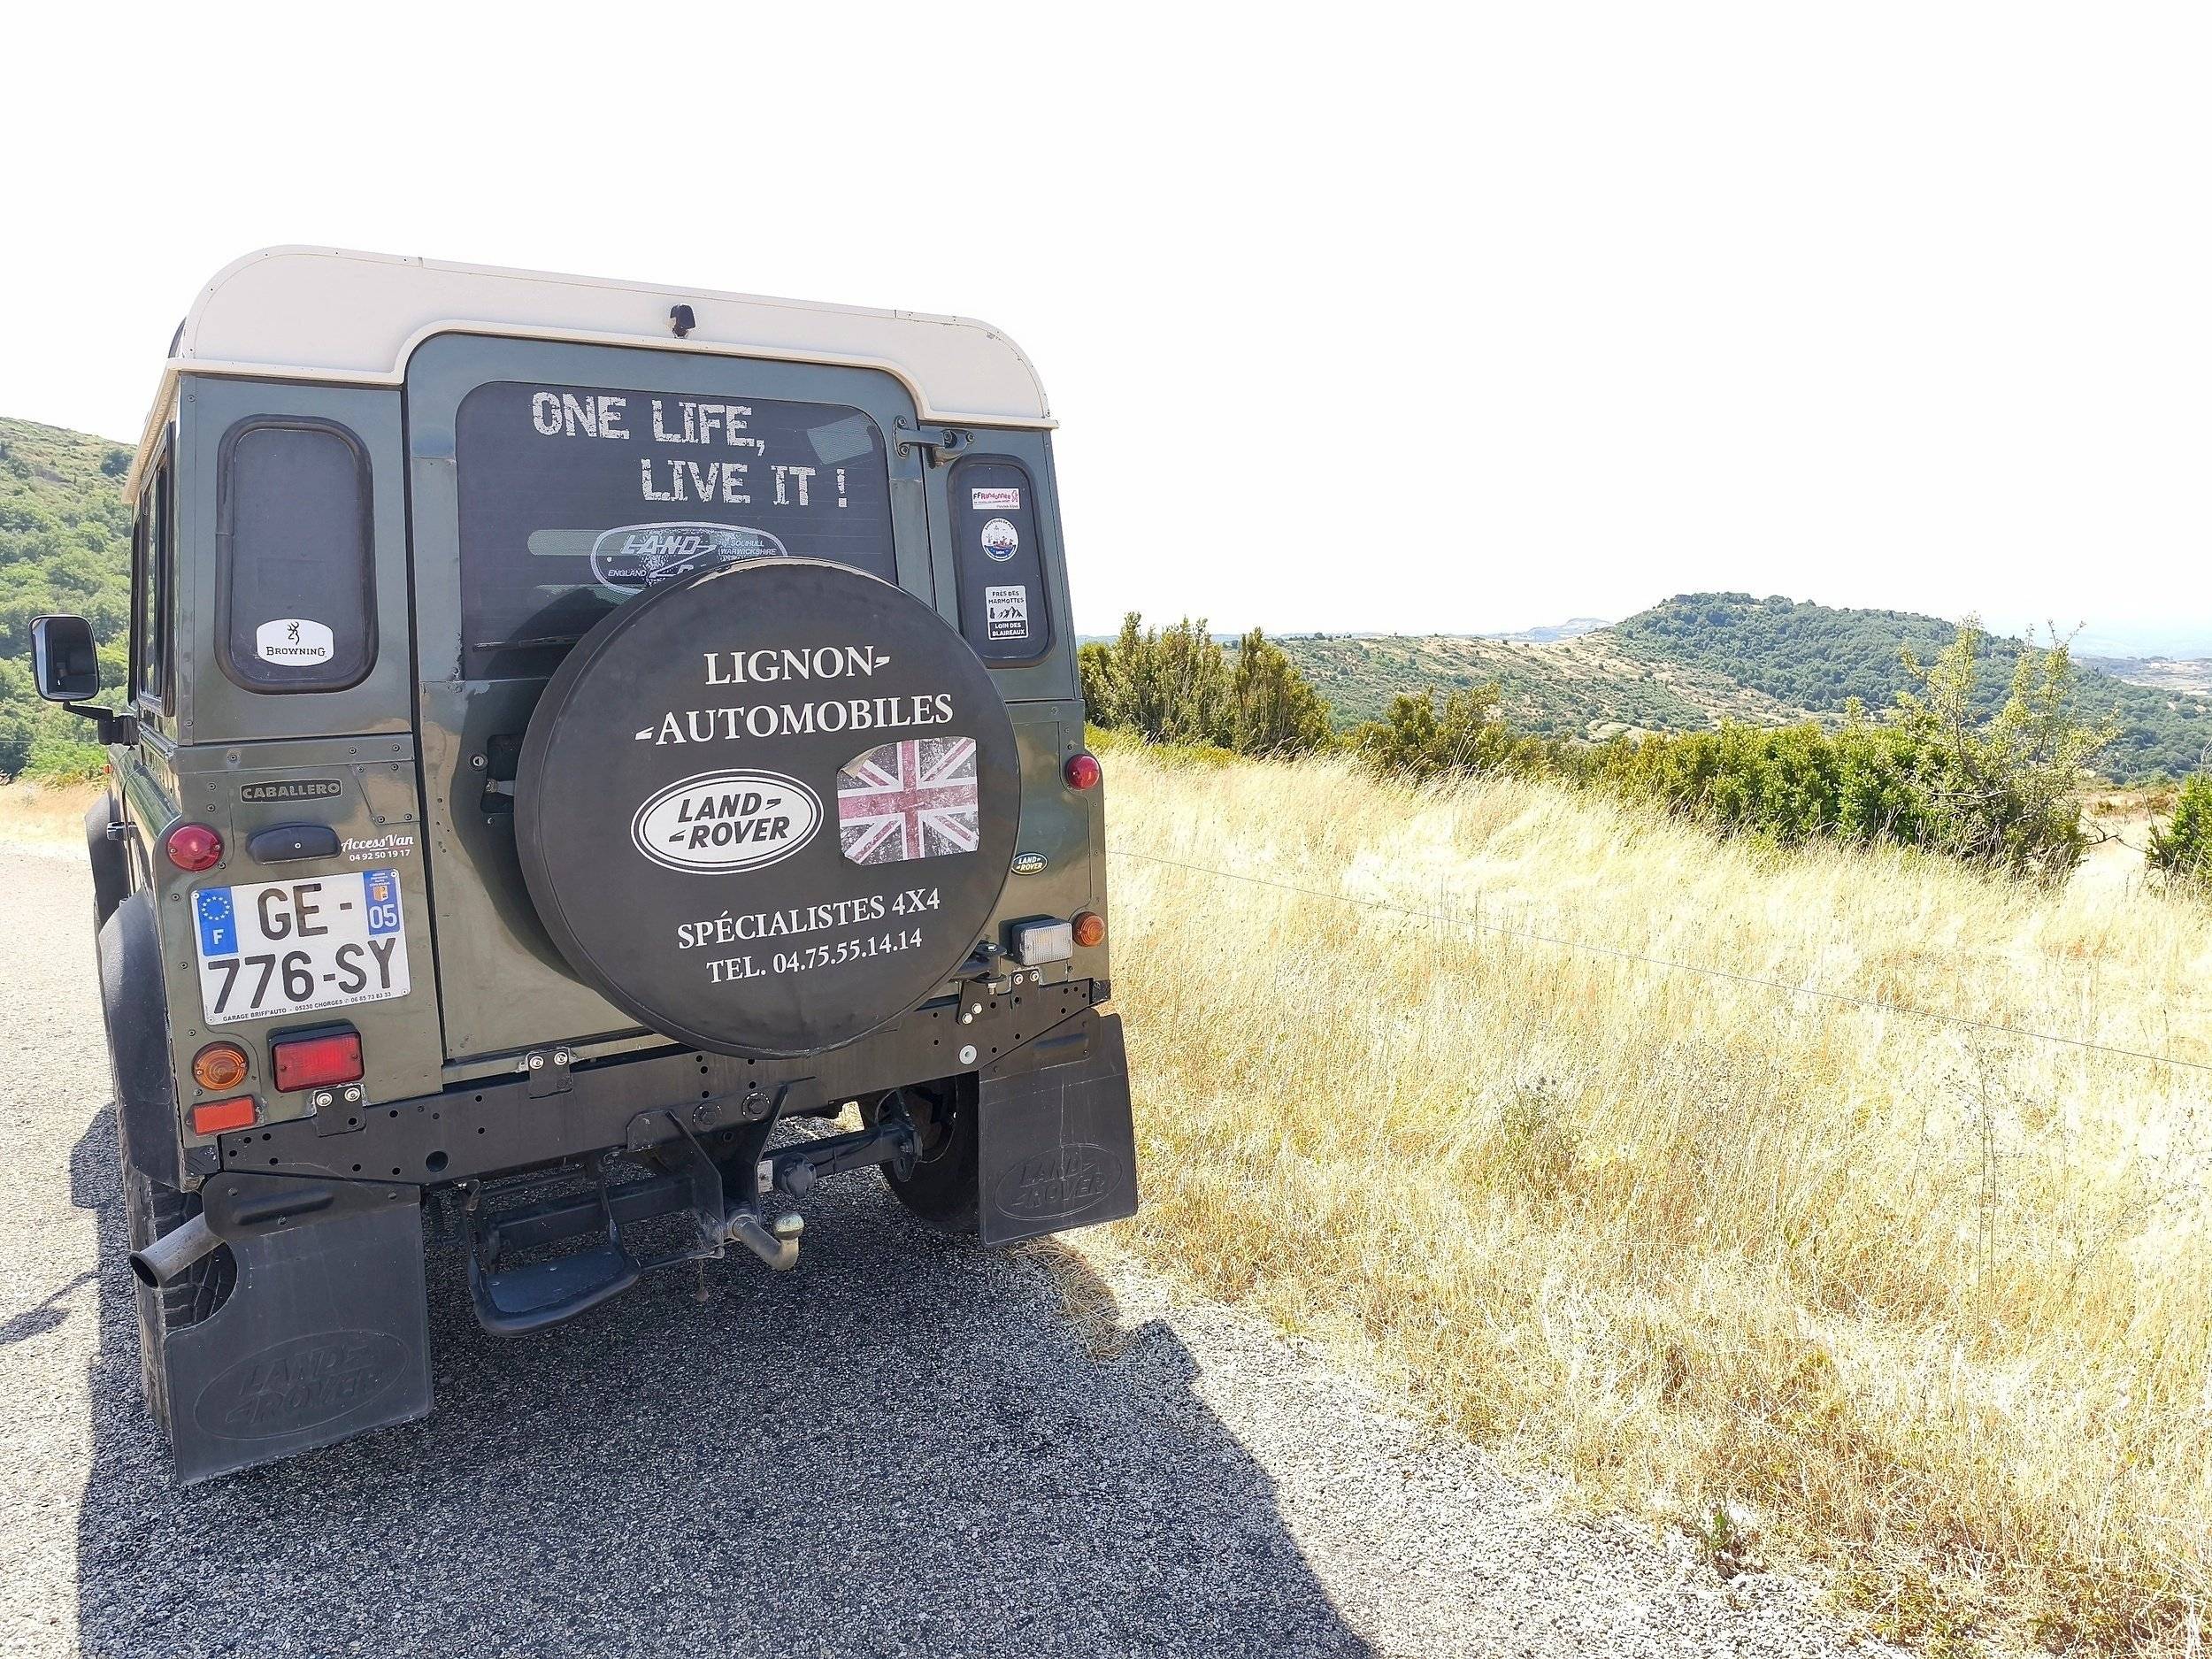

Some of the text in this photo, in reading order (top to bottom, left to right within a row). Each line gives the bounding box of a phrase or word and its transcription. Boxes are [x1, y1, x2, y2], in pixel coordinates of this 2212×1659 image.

[532, 392, 765, 457] ONE LIFE,
[641, 458, 847, 508] LIVE IT !
[242, 783, 340, 799] CABALLERO
[212, 929, 224, 945] F
[369, 903, 398, 929] 05
[677, 887, 941, 949] SPÉCIALISTES 4X4
[208, 937, 396, 1014] 776-SY
[706, 927, 923, 983] TEL. 04.75.55.14.14
[314, 999, 343, 1009] CHORGES
